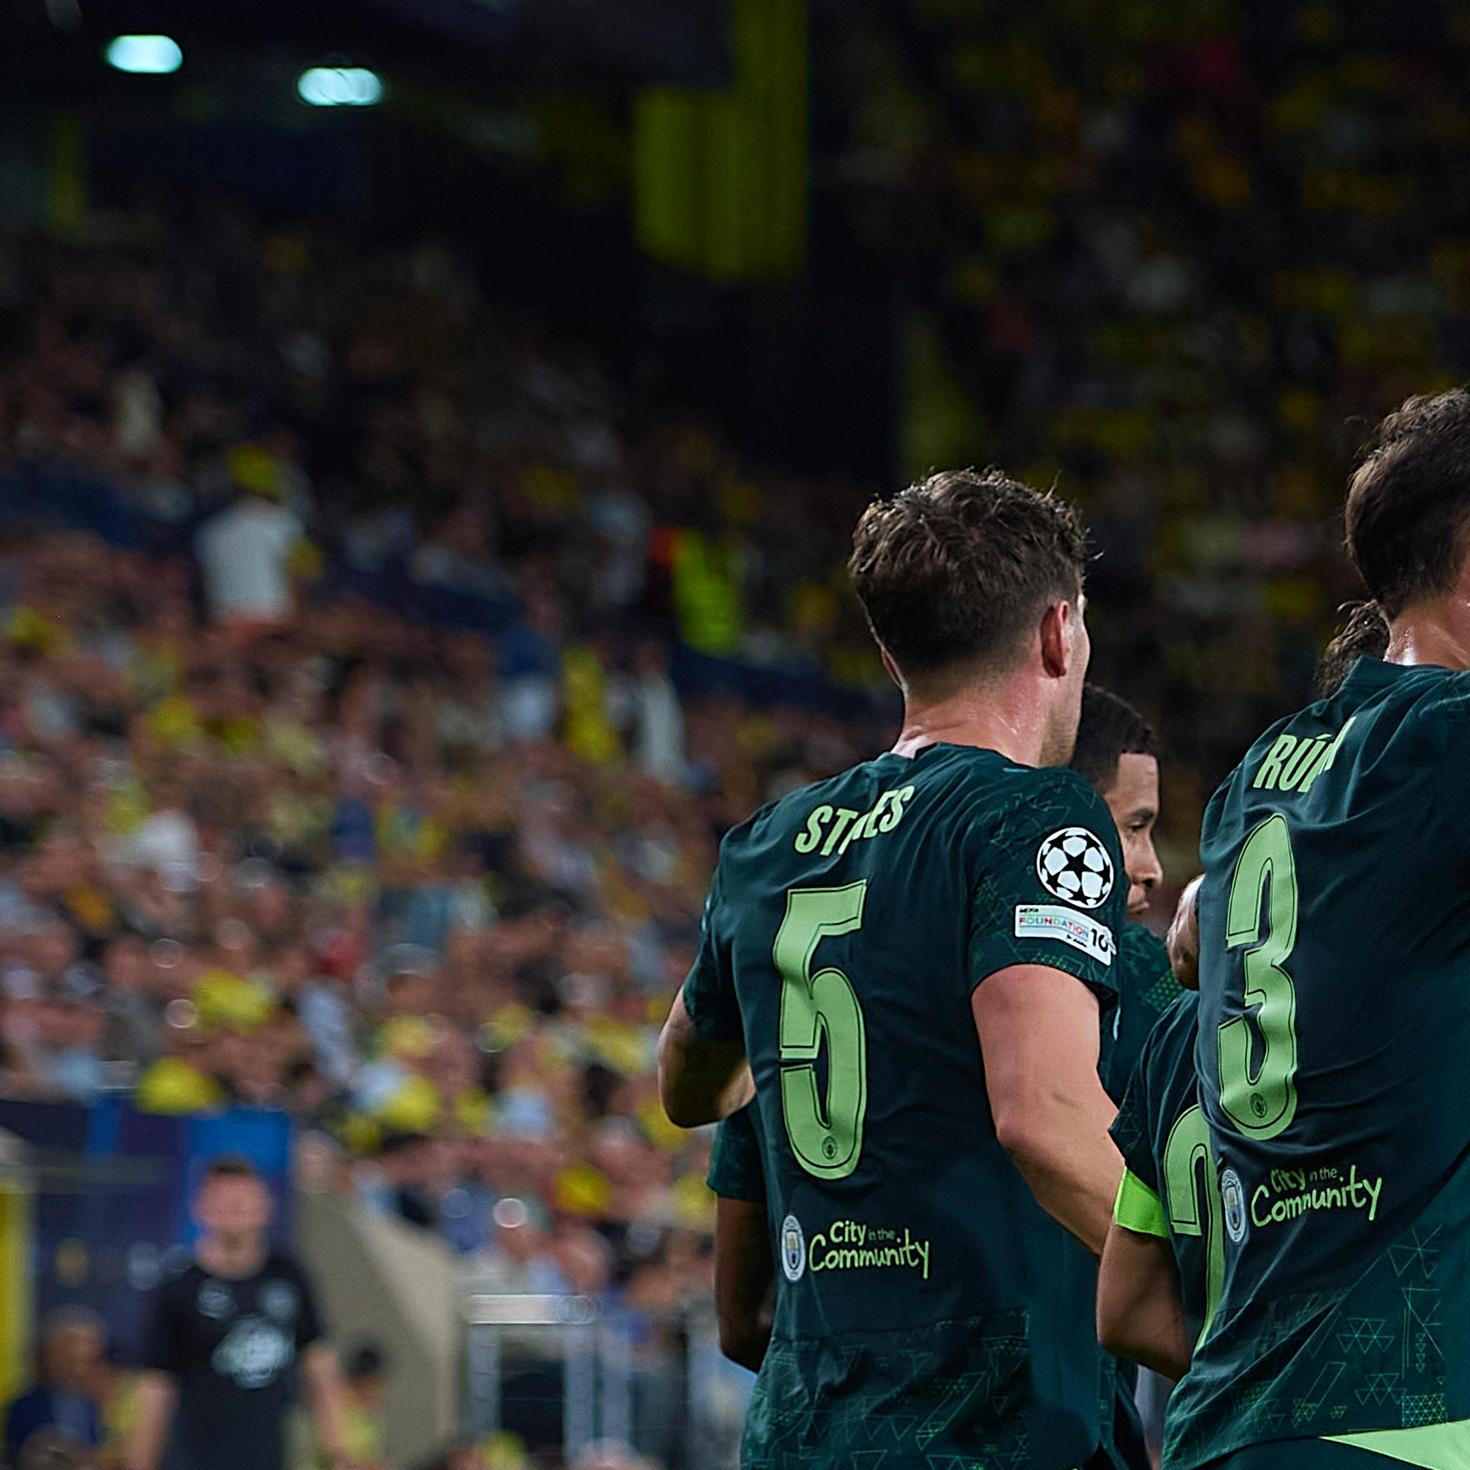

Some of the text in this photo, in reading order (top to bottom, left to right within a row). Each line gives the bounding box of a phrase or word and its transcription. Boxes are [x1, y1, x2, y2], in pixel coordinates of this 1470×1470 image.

[1217, 814, 1297, 1140] 3
[772, 879, 868, 1180] 5
[1251, 1164, 1383, 1227] Community
[1320, 1168, 1338, 1180] the
[809, 1228, 929, 1280] Community
[829, 1220, 867, 1246] City
